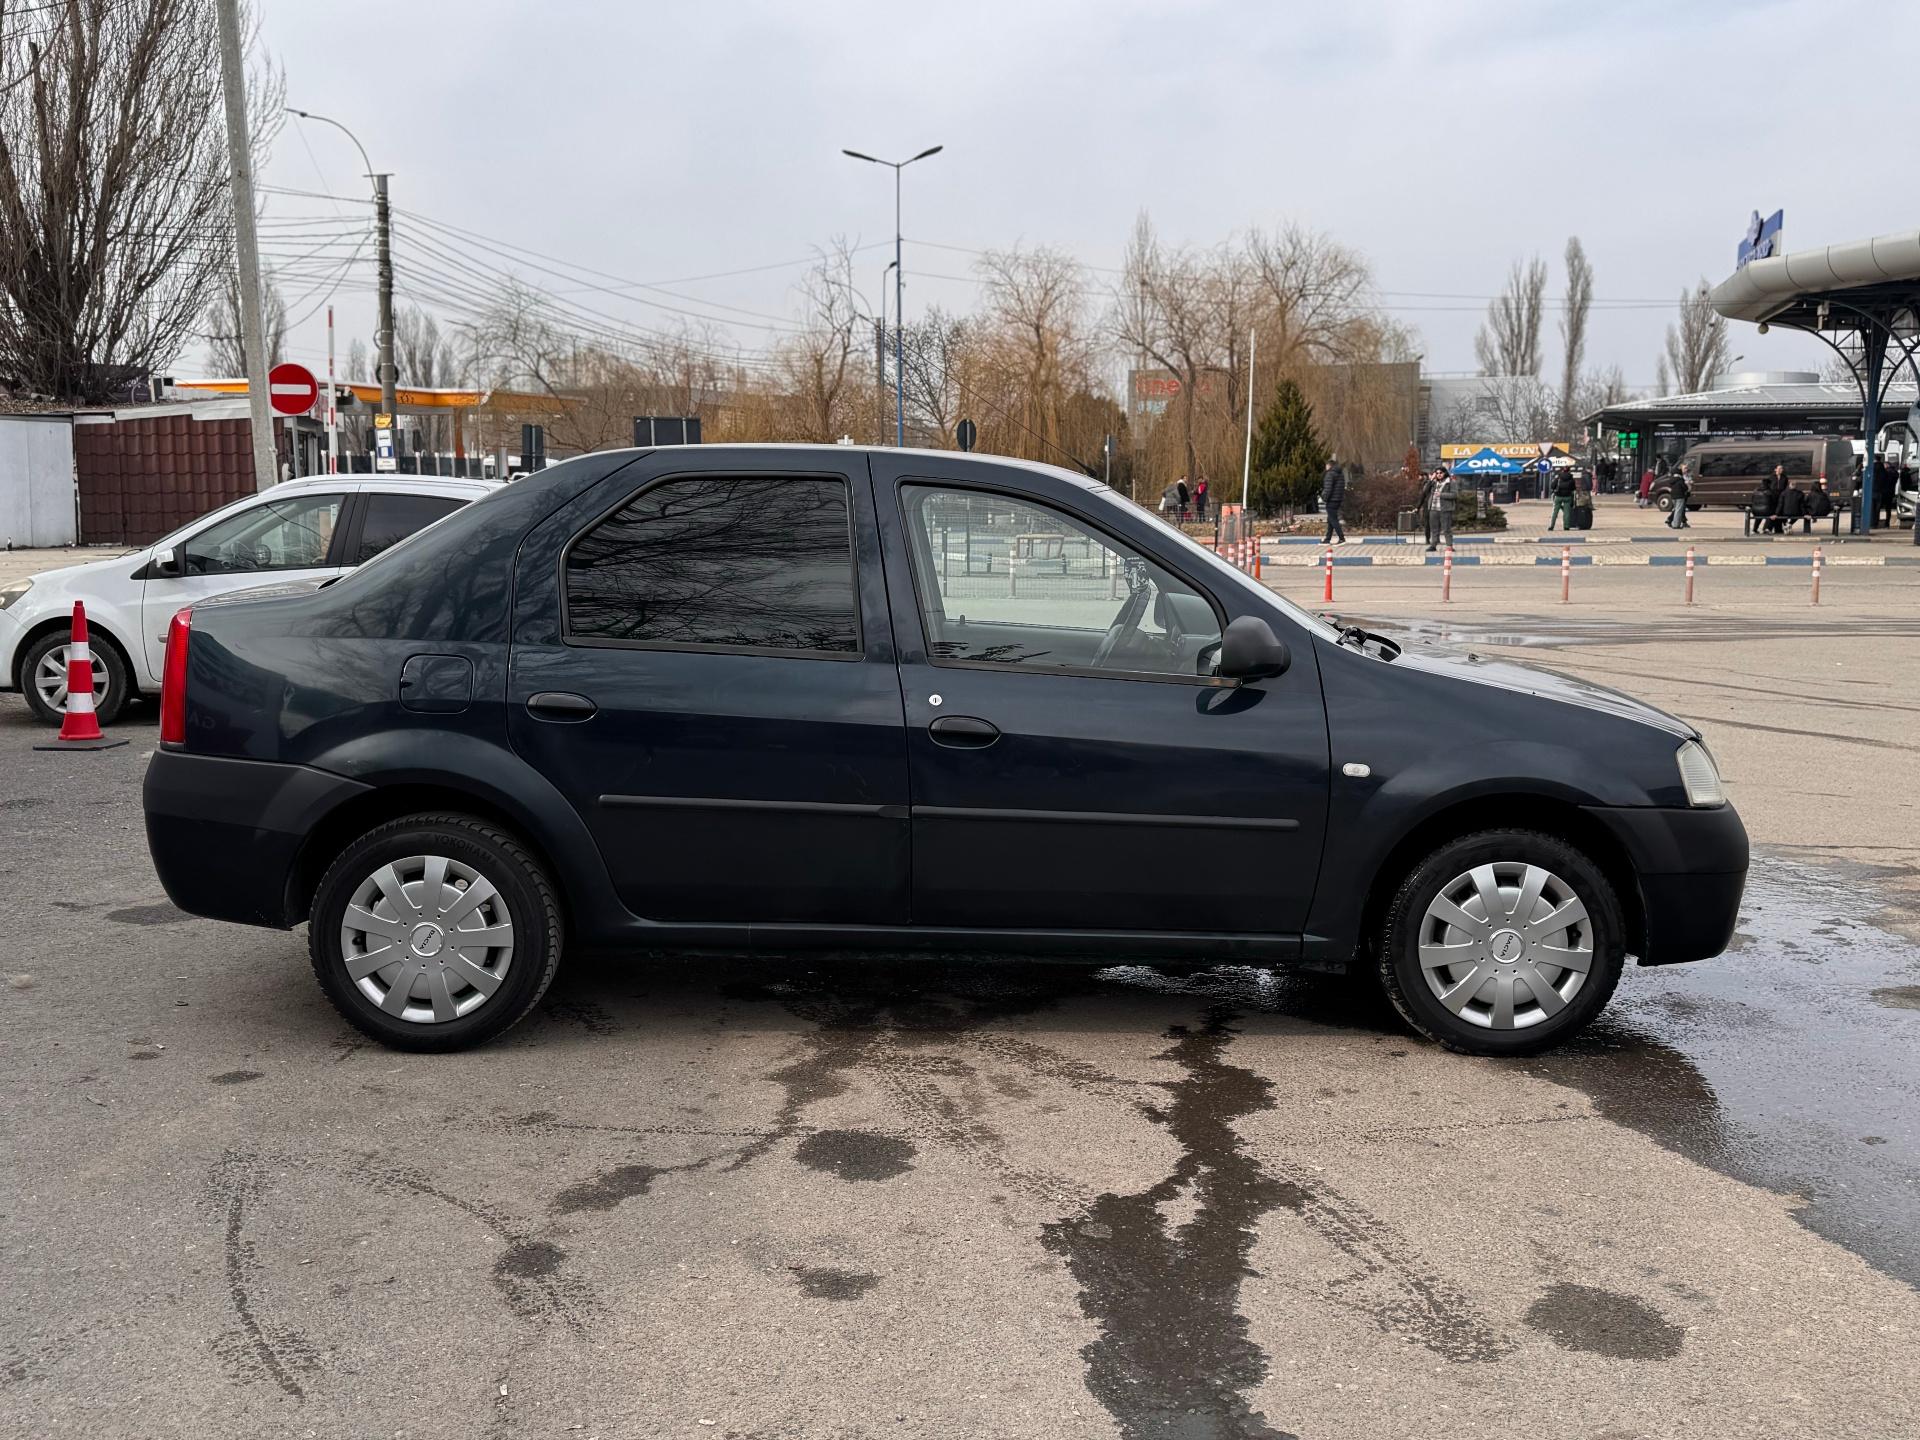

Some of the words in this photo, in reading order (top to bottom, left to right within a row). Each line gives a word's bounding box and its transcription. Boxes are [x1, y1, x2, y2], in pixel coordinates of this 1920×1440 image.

[1453, 447, 1472, 455] LA
[419, 929, 436, 949] DACIA
[1500, 935, 1513, 957] DACIA
